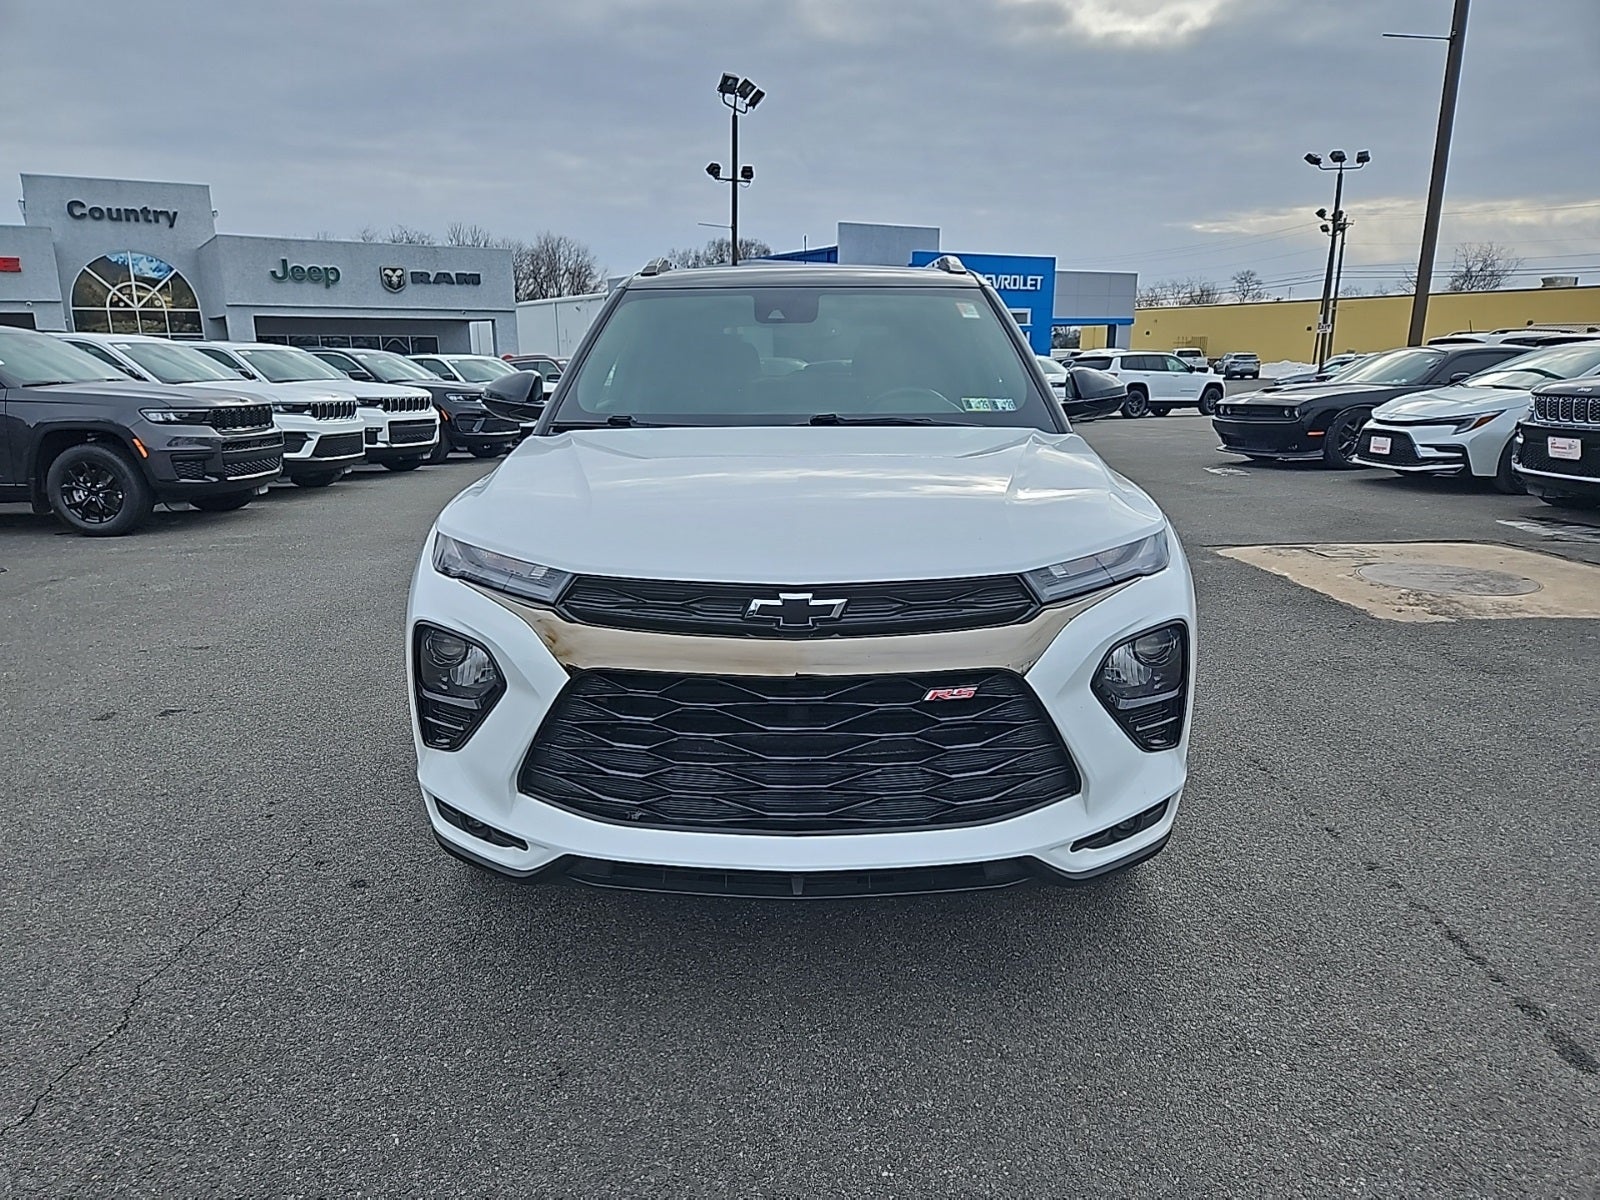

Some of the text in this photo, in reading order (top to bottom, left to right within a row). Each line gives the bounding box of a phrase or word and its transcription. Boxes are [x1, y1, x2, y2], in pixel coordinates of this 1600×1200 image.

[66, 199, 179, 229] Country
[269, 258, 341, 289] Jeep
[409, 270, 482, 286] RAM
[924, 686, 978, 701] RS
